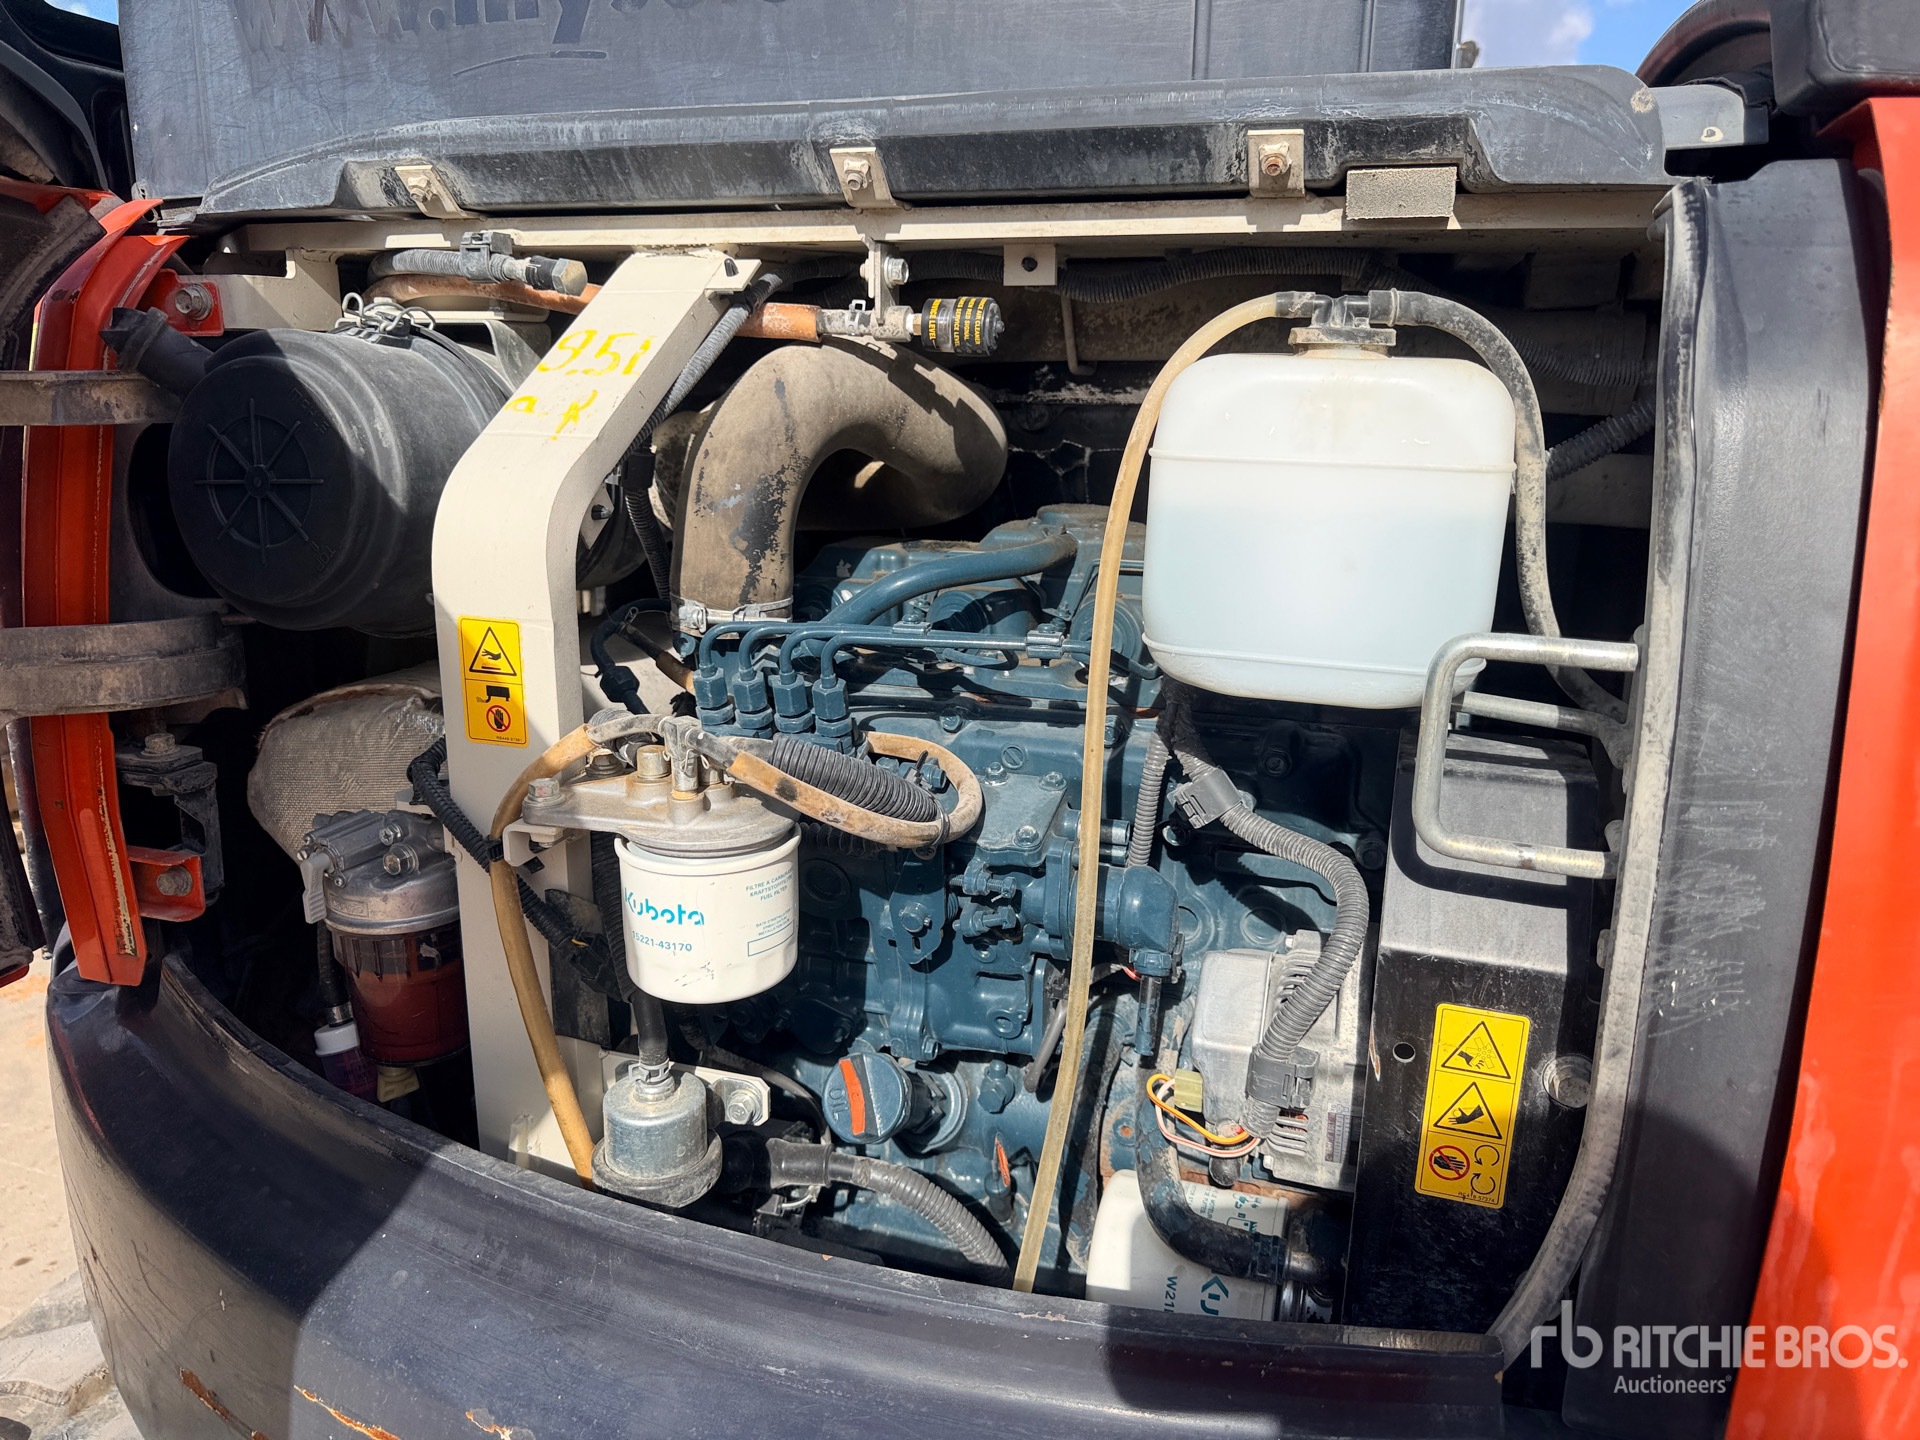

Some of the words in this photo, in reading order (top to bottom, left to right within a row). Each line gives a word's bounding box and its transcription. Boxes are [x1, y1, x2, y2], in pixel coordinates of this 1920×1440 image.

[928, 320, 937, 340] LEVEL
[624, 886, 705, 926] Kubota
[632, 930, 693, 952] 15221-43170
[829, 1087, 849, 1121] OIL
